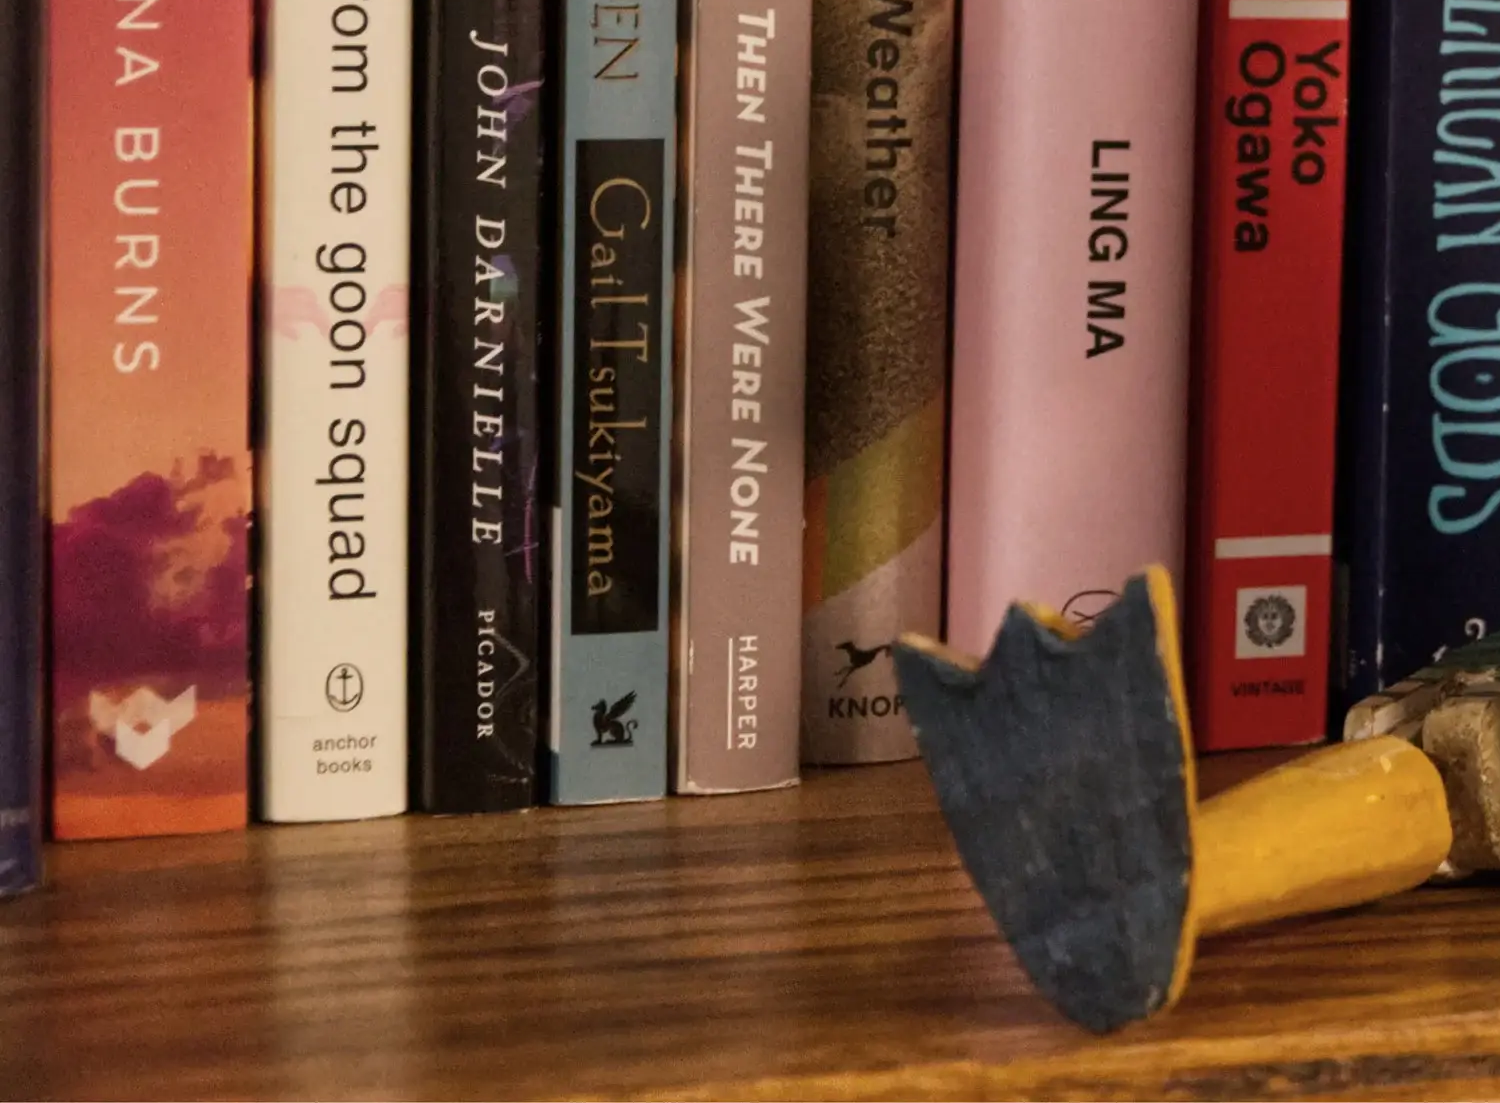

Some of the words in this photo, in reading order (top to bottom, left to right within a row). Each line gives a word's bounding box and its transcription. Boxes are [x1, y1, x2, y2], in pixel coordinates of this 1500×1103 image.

[470, 30, 508, 188] JOHN
[736, 9, 775, 123] THEN
[1291, 40, 1342, 186] Yoko
[330, 121, 378, 215] the
[733, 140, 773, 280] THERE
[1088, 140, 1131, 263] LING
[1224, 41, 1286, 253] Ogawa
[113, 127, 161, 373] BURNS
[590, 178, 652, 309] Gail
[316, 242, 367, 389] goon
[472, 215, 505, 545] DARNIELLE
[731, 296, 771, 424] WERE
[1085, 281, 1127, 360] MA
[315, 418, 377, 600] squad
[574, 322, 648, 597] Tsukiyama
[729, 438, 768, 566] NONE
[477, 610, 495, 739] PICADOR
[737, 635, 758, 751] HARPER
[312, 733, 377, 753] anchor
[317, 755, 373, 774] books
